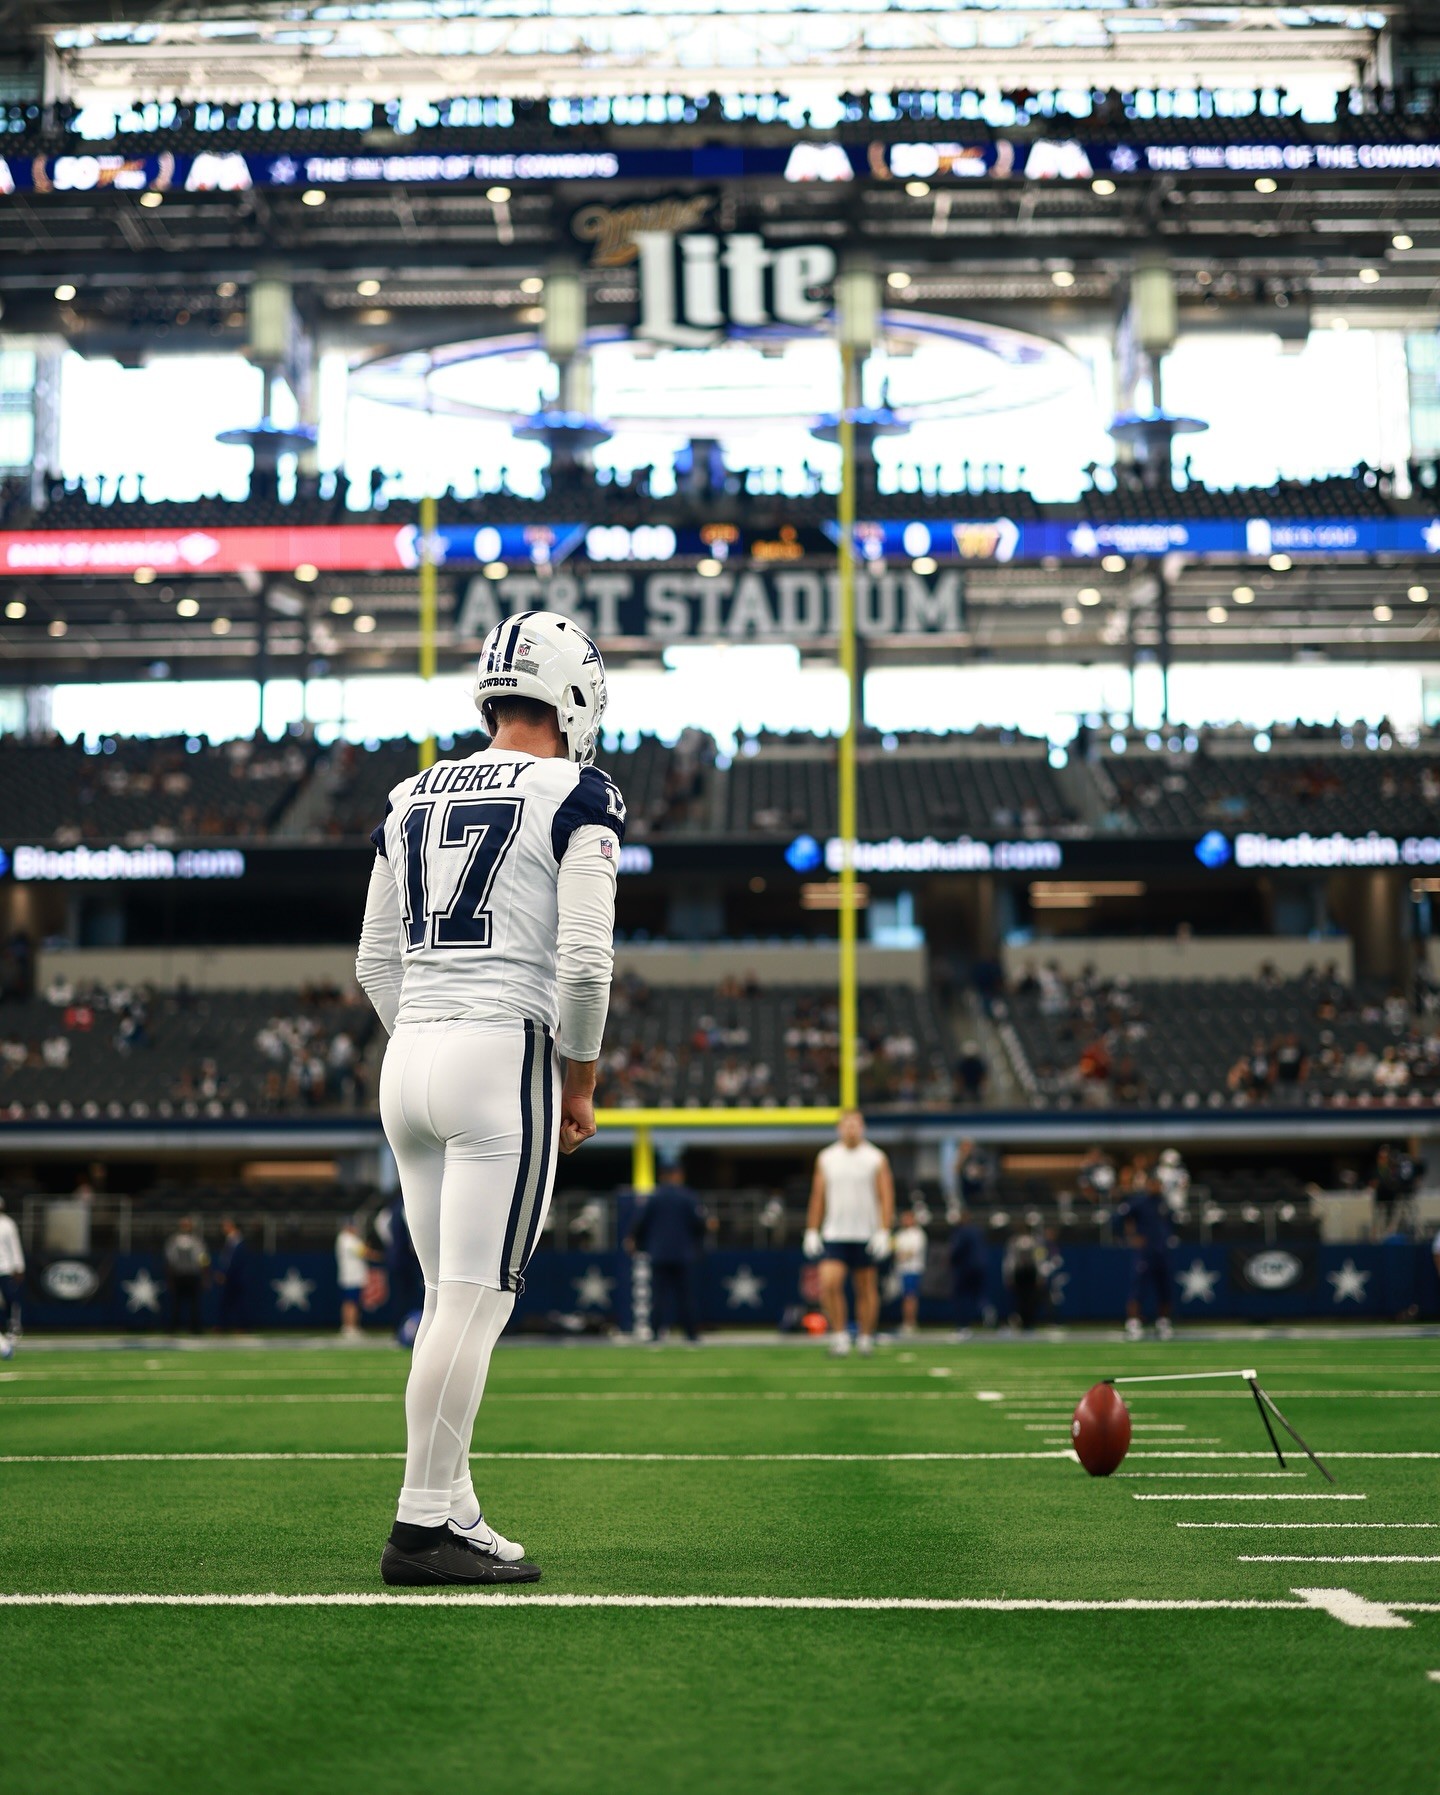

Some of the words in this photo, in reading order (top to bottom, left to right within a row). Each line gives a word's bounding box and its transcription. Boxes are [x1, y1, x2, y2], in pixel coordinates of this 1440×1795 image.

[631, 230, 837, 346] Lite
[479, 677, 518, 690] COWBOYS
[409, 761, 536, 797] AUBREY
[400, 797, 526, 952] 17
